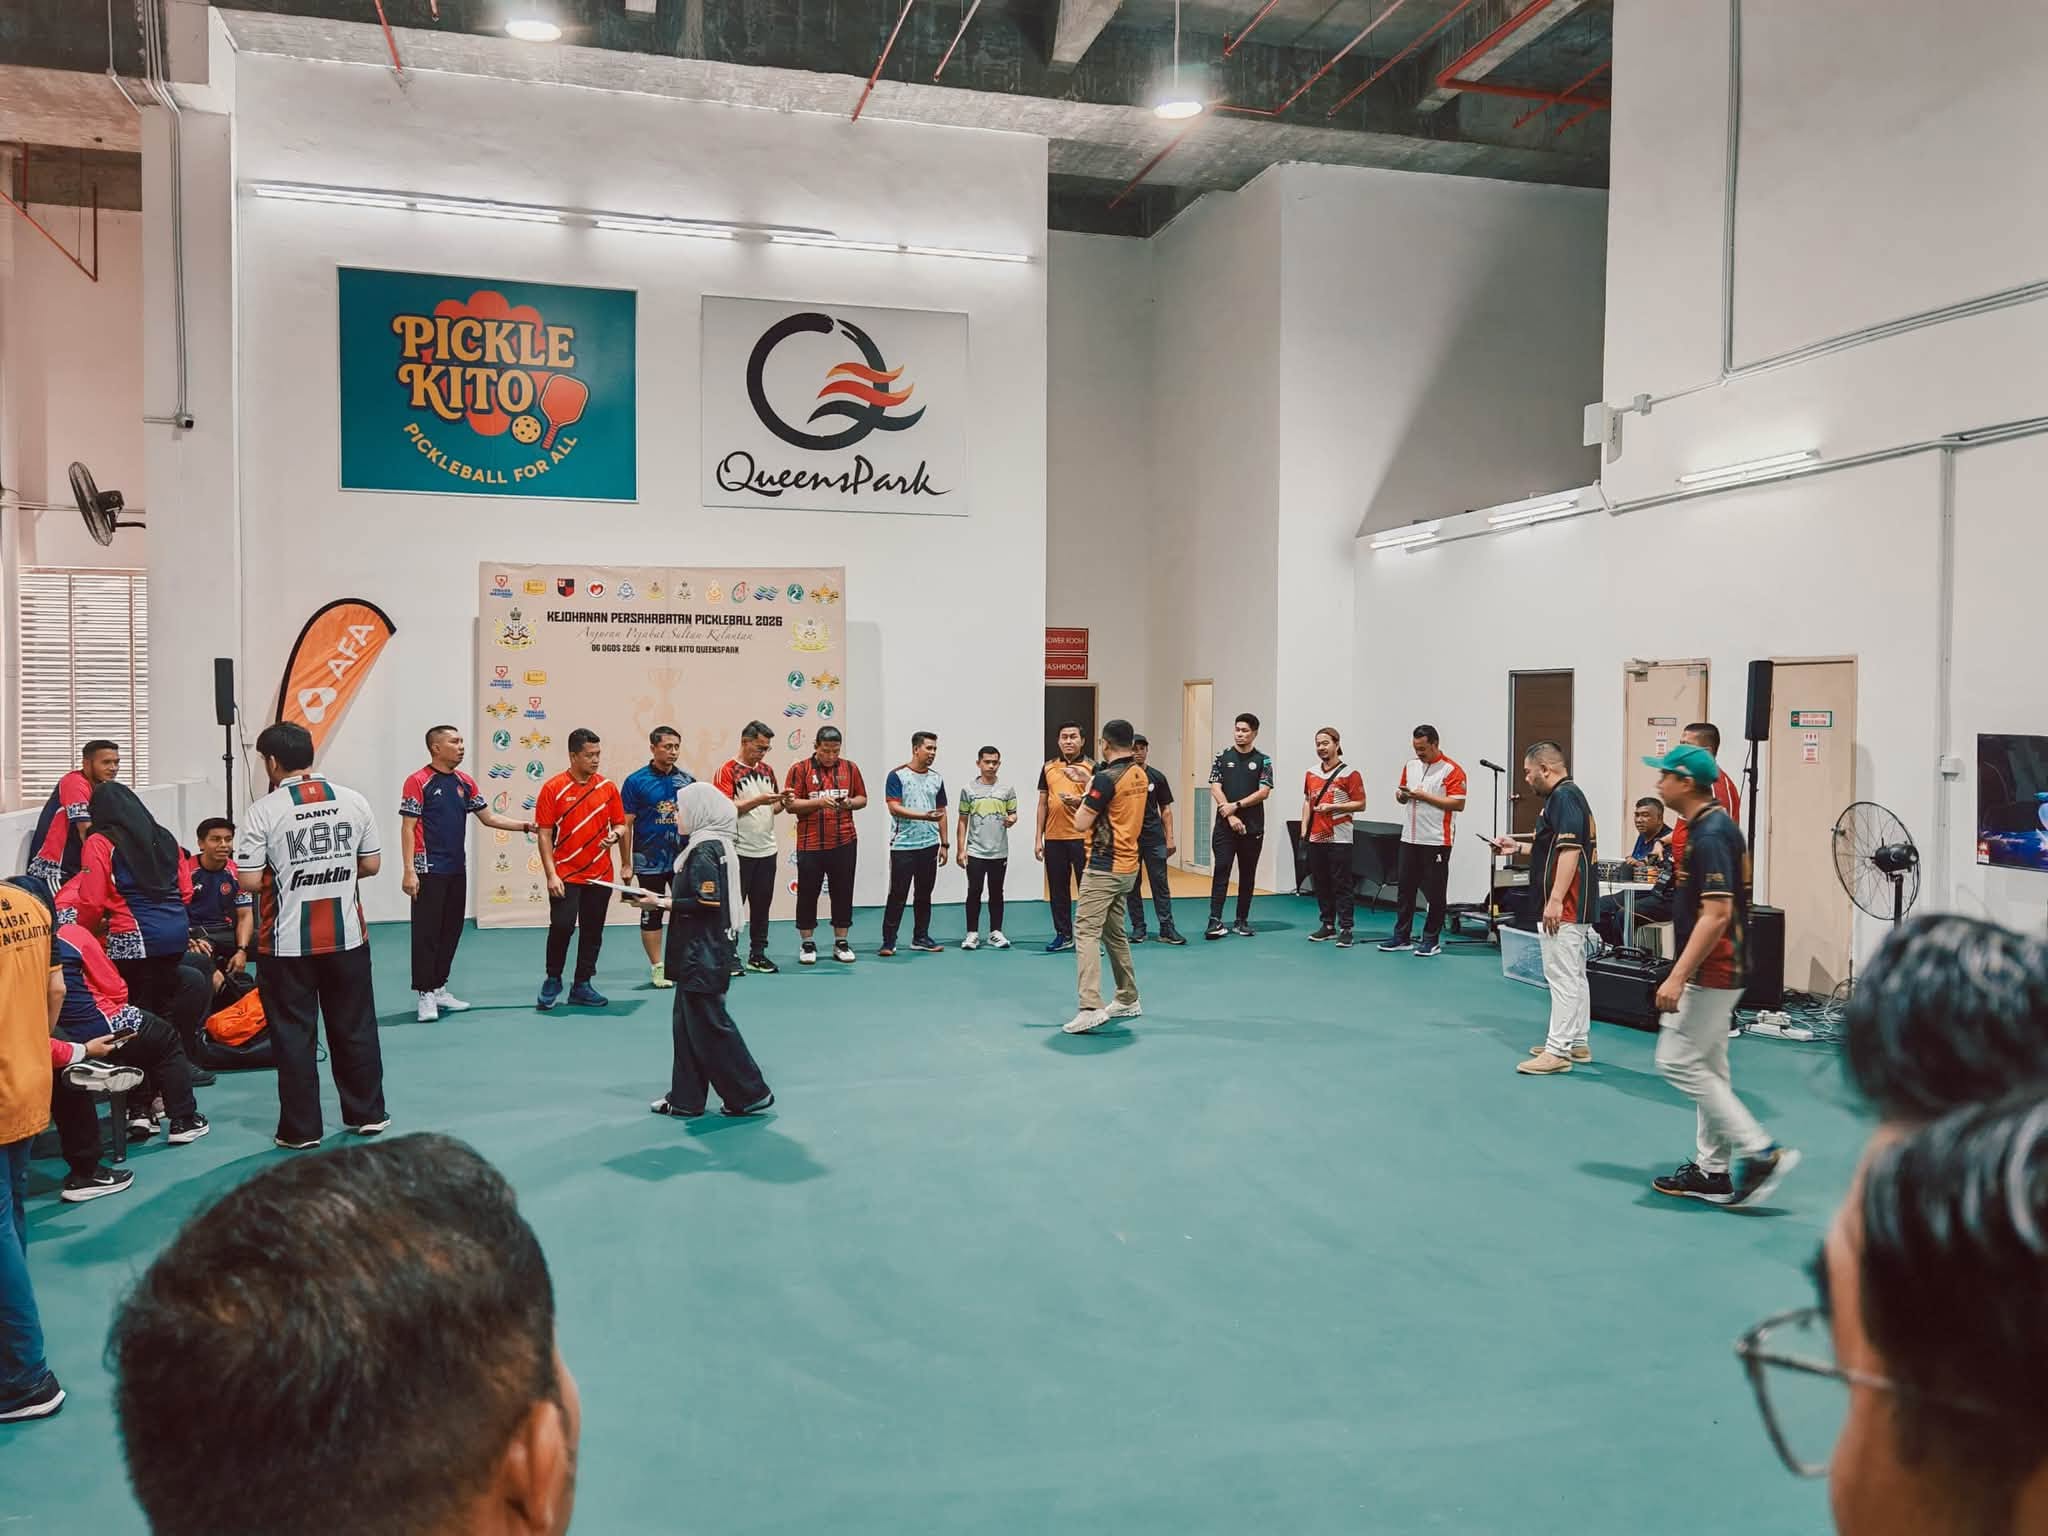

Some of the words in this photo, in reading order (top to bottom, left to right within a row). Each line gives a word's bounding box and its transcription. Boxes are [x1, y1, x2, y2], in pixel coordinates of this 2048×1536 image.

[392, 315, 575, 368] PICKLE
[398, 363, 534, 420] KITO
[403, 422, 508, 484] PICKLEBALL
[513, 459, 550, 482] FOR
[550, 435, 578, 465] ALL
[716, 450, 952, 498] QueensPark
[547, 611, 608, 623] KEJOHANAN
[611, 612, 692, 625] PERSAHABATAN
[695, 614, 753, 626] PICKLEBALL
[755, 615, 783, 627] 2026
[327, 624, 375, 681] AFA
[602, 643, 621, 653] OGOS
[622, 644, 641, 653] 2026
[654, 644, 677, 654] PICKLE
[678, 645, 695, 654] KITO
[696, 645, 739, 655] QUEENSPARK
[1045, 663, 1085, 671] ASHROOM
[295, 808, 339, 821] DANNY
